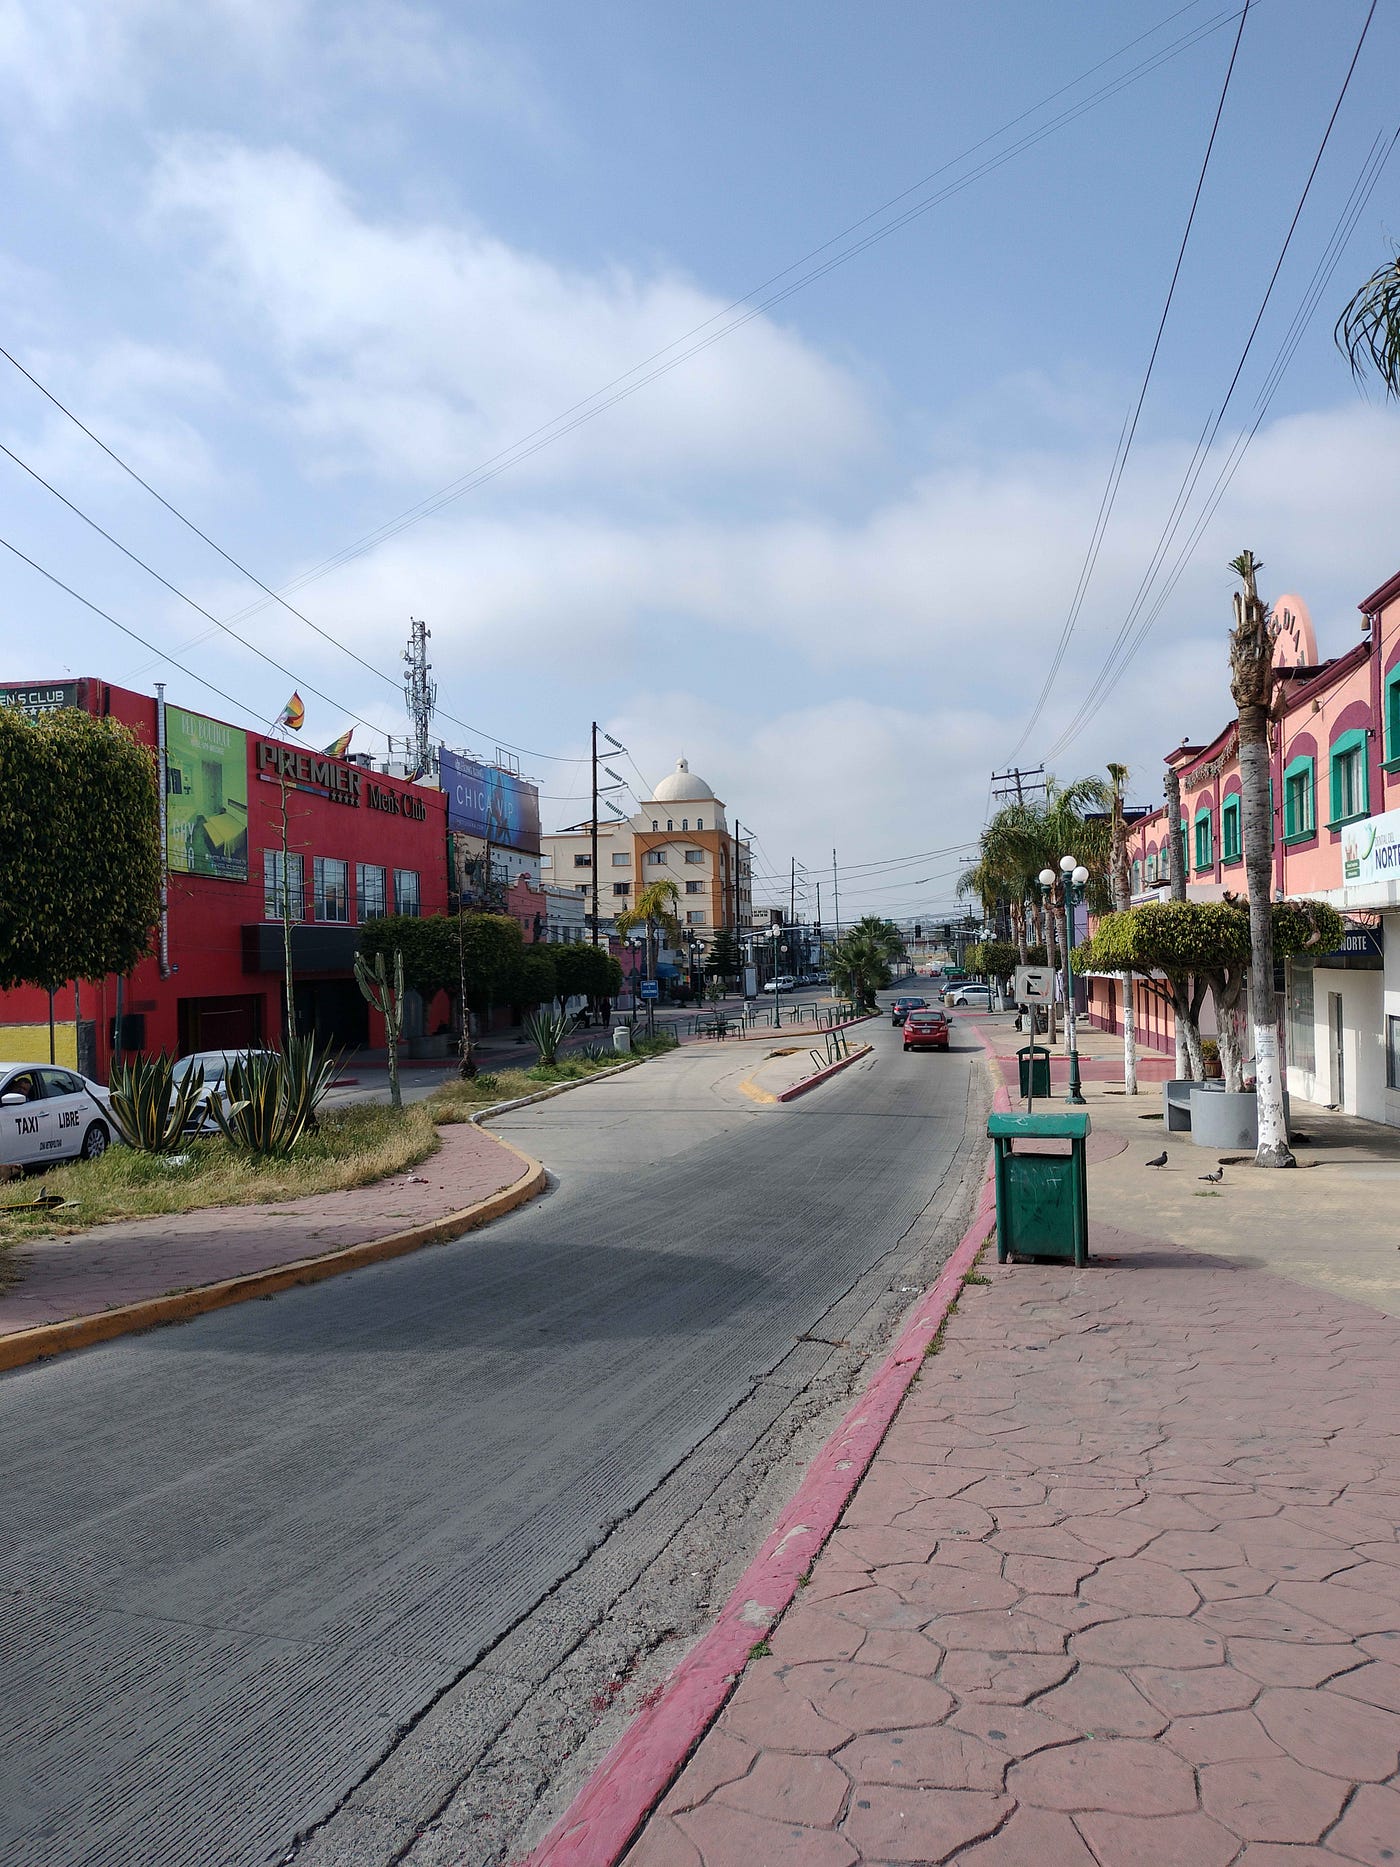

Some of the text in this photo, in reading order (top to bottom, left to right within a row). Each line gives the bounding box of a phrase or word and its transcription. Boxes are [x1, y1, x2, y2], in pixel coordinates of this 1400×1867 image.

[29, 690, 64, 704] CLUB
[257, 742, 361, 796] PREMIER
[368, 784, 426, 821] Men's Club
[456, 784, 492, 814] CHICA
[1340, 936, 1367, 951] NORTE
[15, 1110, 80, 1135] TAXI LIBRE
